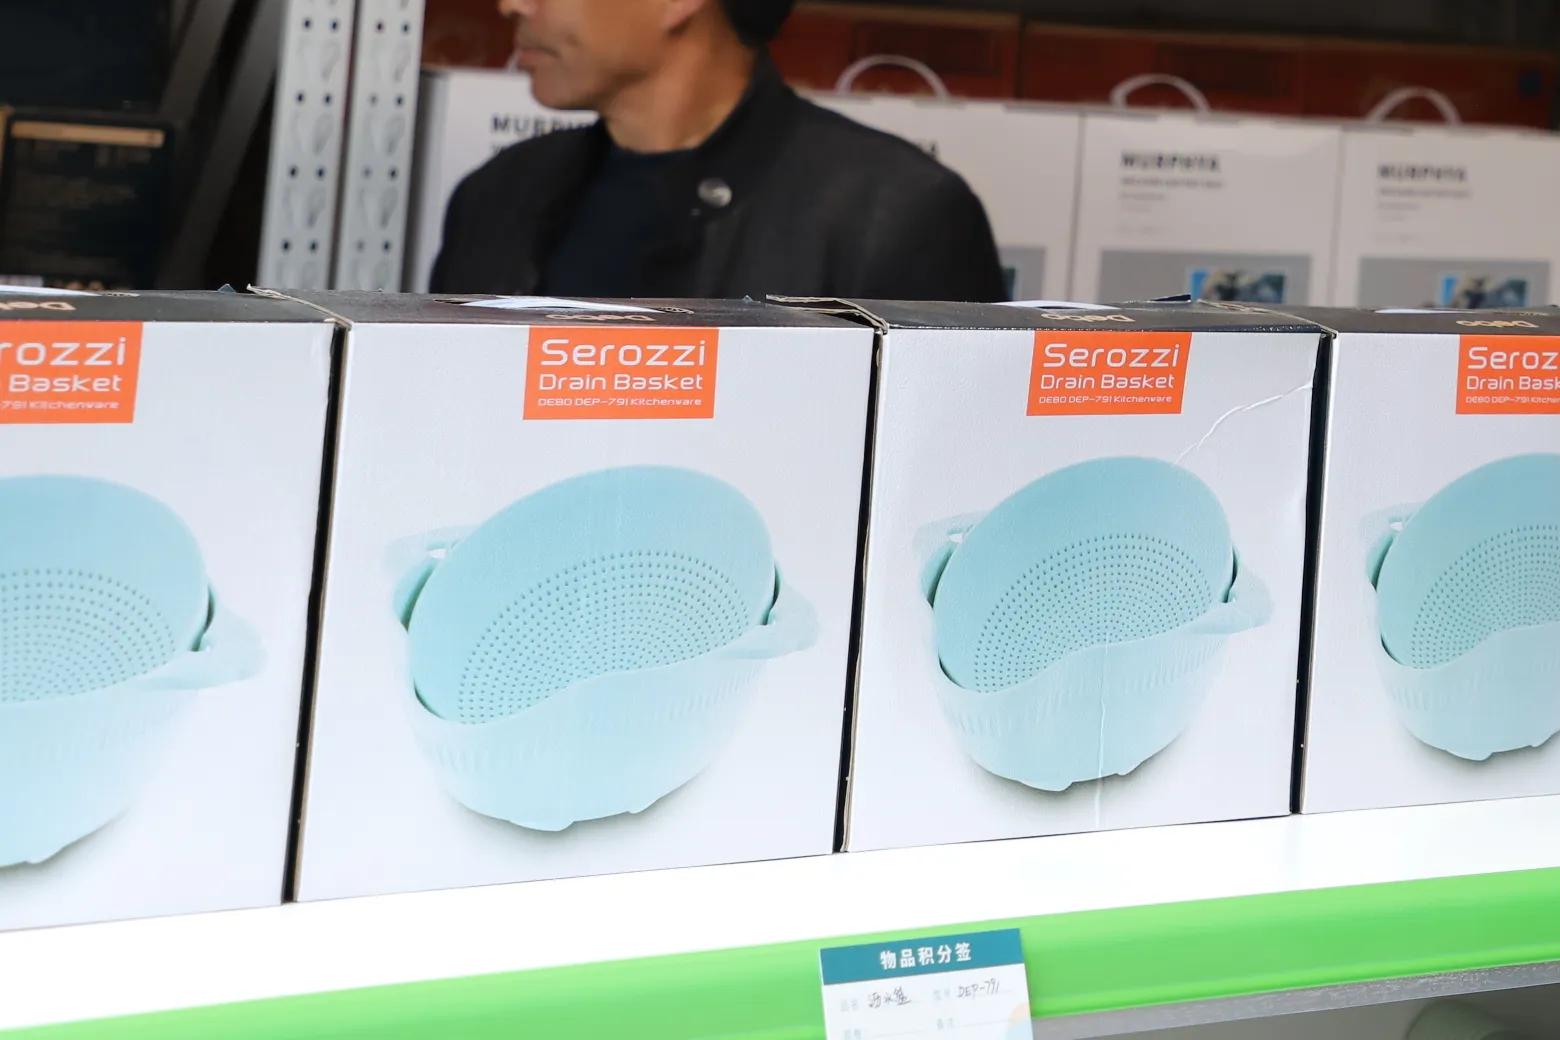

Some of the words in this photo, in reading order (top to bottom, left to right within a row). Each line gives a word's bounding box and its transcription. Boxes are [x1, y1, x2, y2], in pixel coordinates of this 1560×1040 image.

[540, 338, 706, 366] Serozzi
[1043, 343, 1179, 368] Serozzi
[9, 374, 122, 392] Basket
[538, 373, 606, 390] Drain
[614, 373, 704, 390] Basket
[1040, 374, 1095, 390] Drain
[1101, 373, 1175, 389] Basket
[1466, 375, 1514, 390] Drain
[631, 397, 702, 406] Kitchenware
[1114, 395, 1173, 403] Kitchenware
[880, 942, 971, 970] 物品积分签
